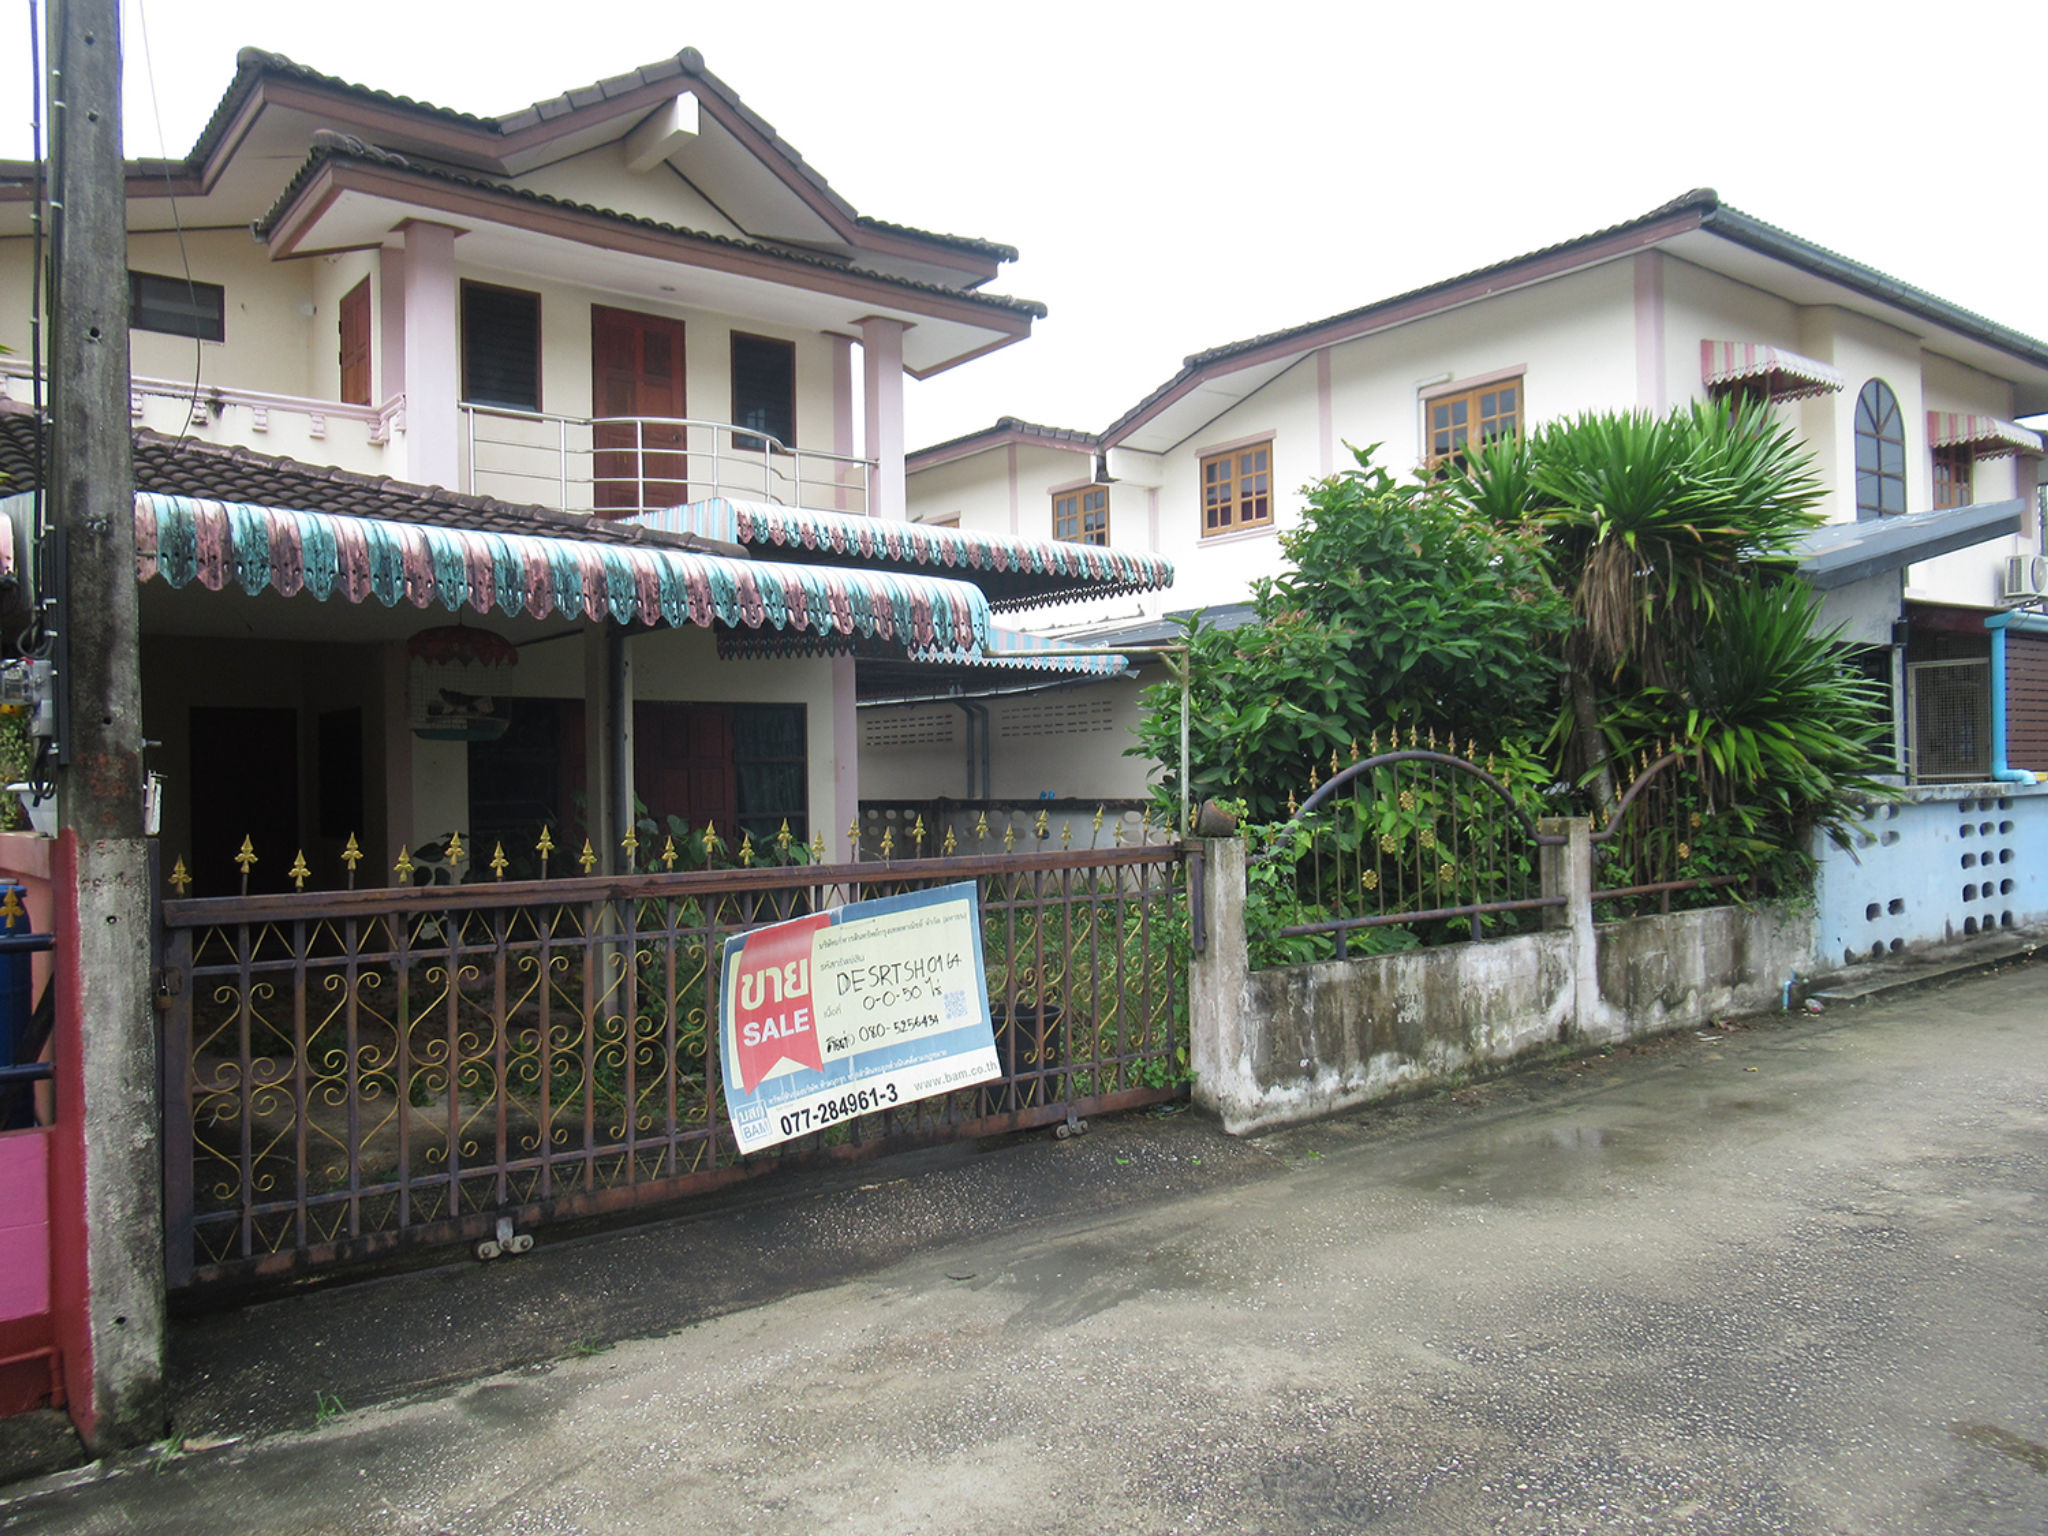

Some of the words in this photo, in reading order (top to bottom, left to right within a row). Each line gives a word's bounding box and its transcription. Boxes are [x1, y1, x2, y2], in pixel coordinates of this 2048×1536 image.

[741, 958, 809, 1011] ขาย
[862, 985, 922, 1010] 0-0-50
[743, 1007, 810, 1047] SALE
[913, 1060, 998, 1092] www.bam.co.th
[780, 1082, 898, 1136] 077-284961-3
